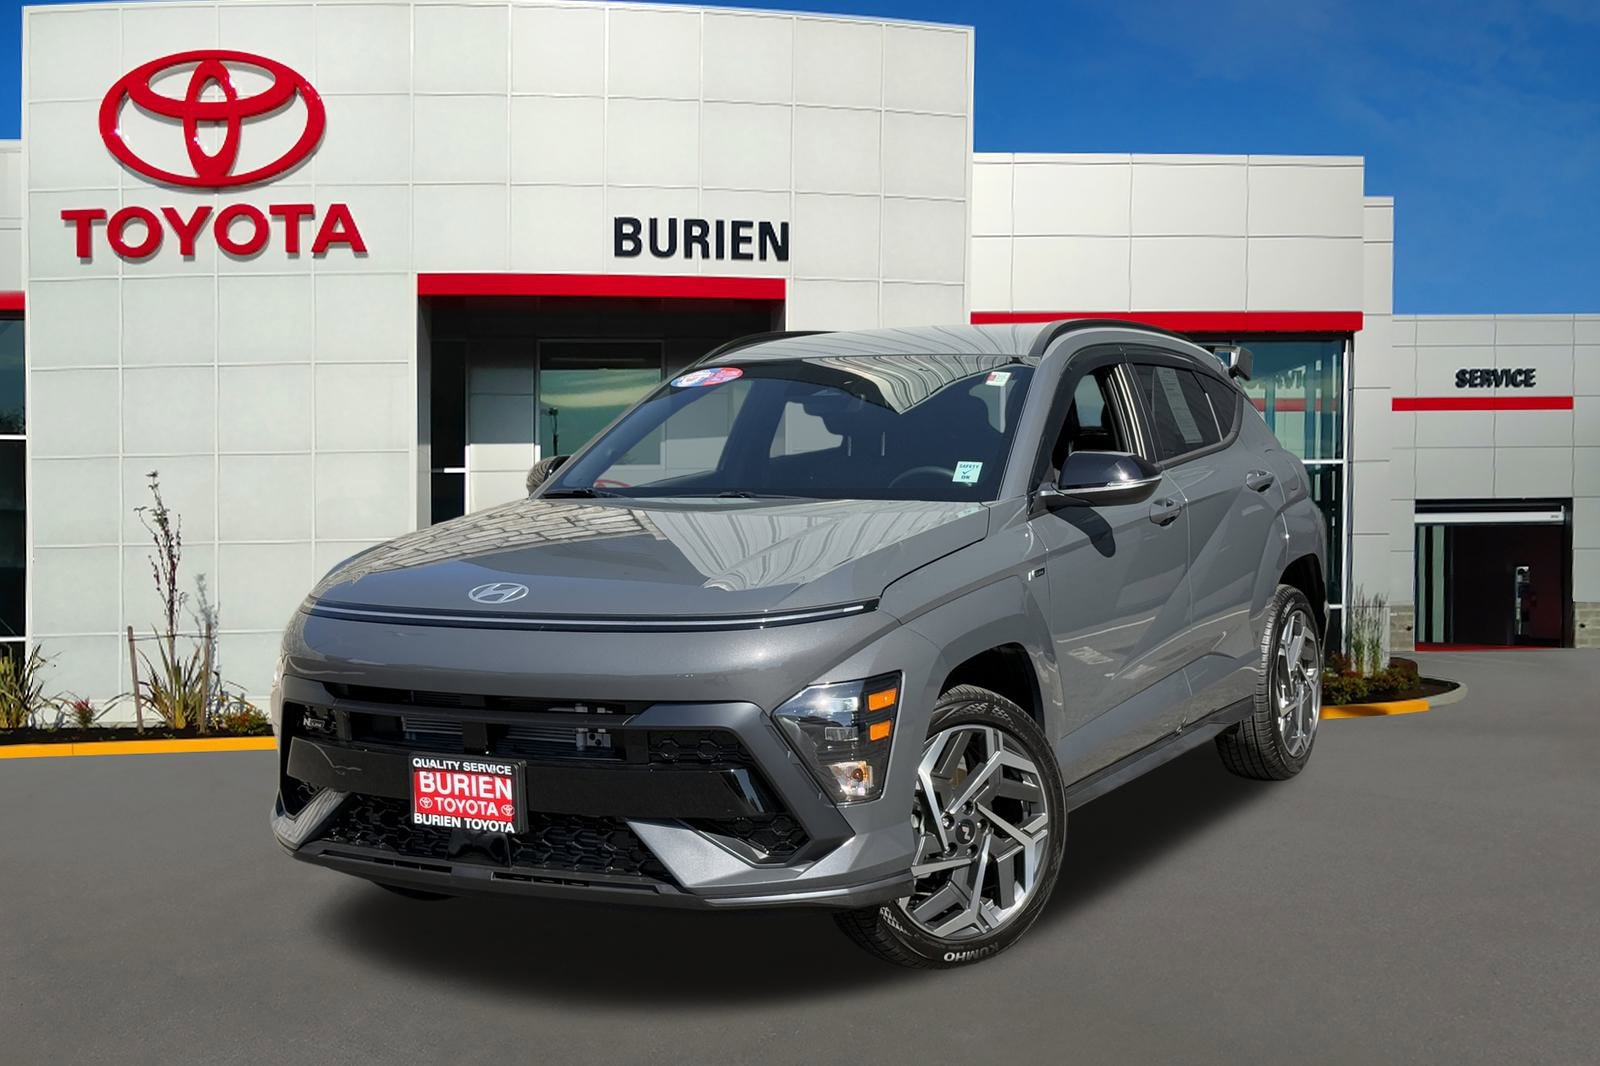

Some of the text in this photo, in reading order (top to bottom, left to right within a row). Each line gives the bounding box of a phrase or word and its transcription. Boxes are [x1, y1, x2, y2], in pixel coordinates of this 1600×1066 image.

[60, 203, 368, 258] TOYOTA
[614, 217, 789, 261] BURIEN
[1455, 368, 1536, 388] SERVICE
[412, 758, 512, 775] QUALITY SERVICE
[419, 771, 512, 800] BURIEN
[434, 797, 499, 816] TOYOTA
[414, 813, 515, 833] BURIEN TOYOTA
